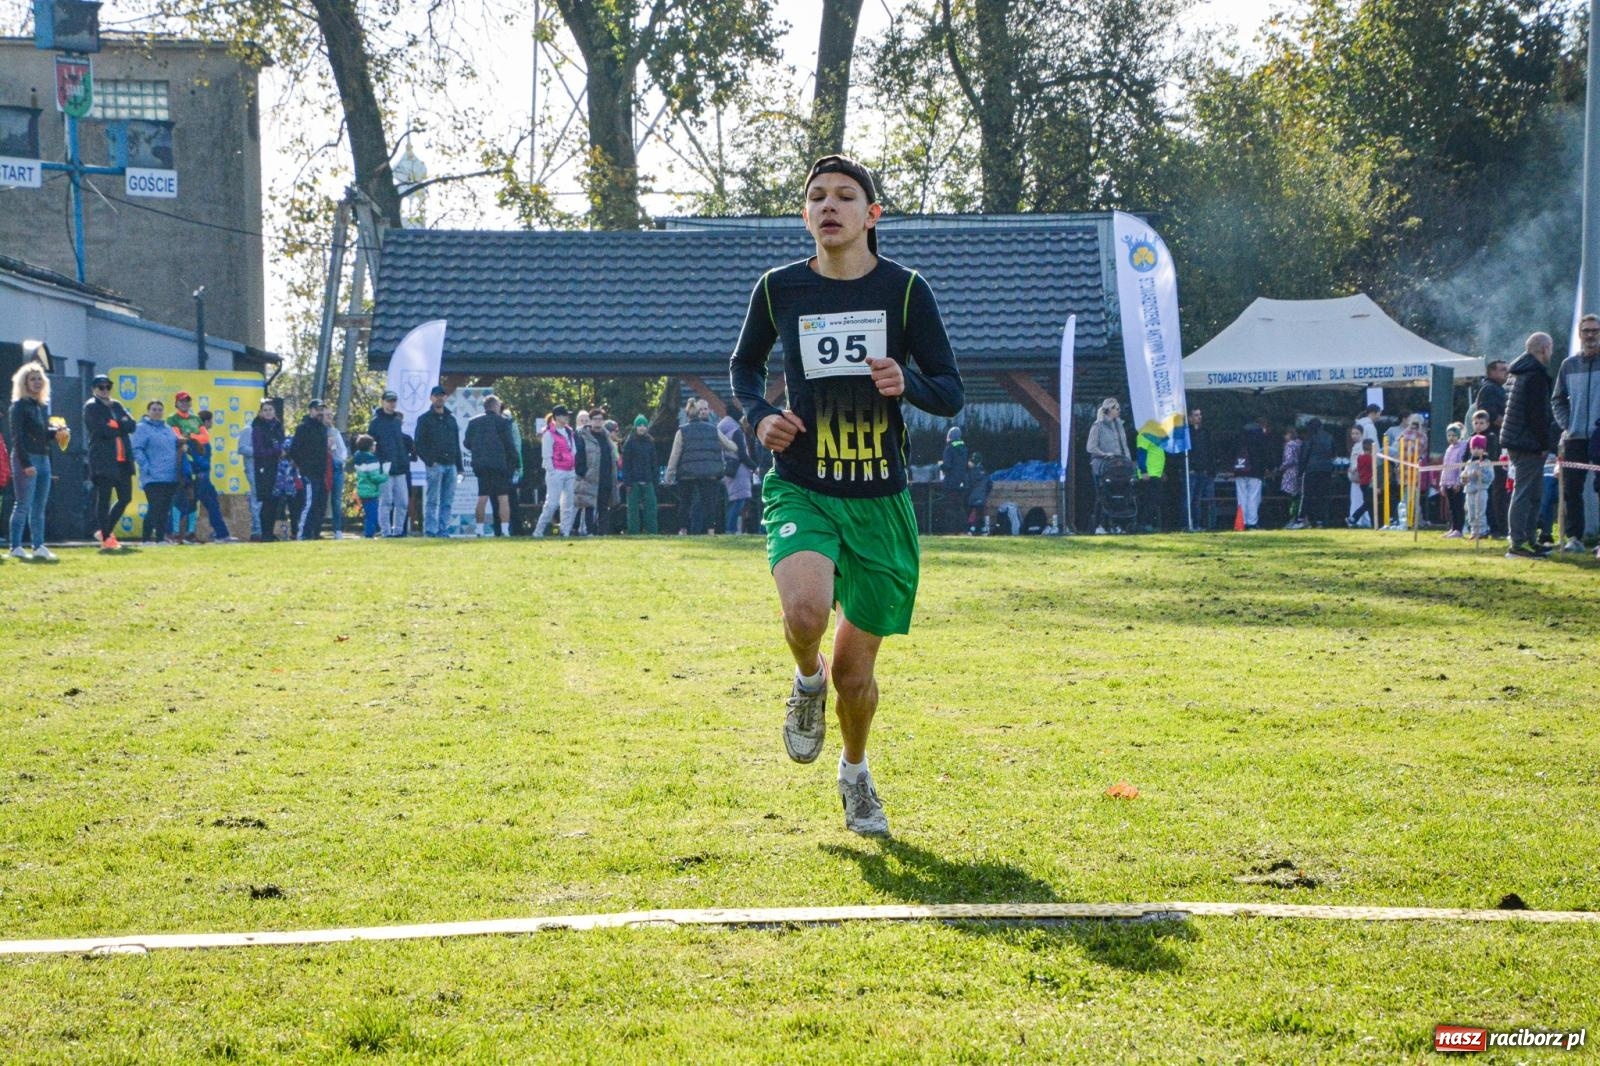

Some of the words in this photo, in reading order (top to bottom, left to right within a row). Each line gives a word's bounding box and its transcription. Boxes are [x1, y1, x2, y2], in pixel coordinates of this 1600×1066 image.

[0, 164, 34, 182] TART
[129, 172, 175, 193] GOŚCIE
[817, 334, 868, 365] 95
[1207, 370, 1279, 385] STOWARZYSZENIE
[1286, 369, 1322, 382] AKTYWNI
[1329, 367, 1345, 380] DLA
[1353, 366, 1395, 379] LEPSZEGO
[1402, 364, 1428, 377] JUTRA
[815, 398, 888, 460] KEEP
[817, 459, 889, 481] GOING
